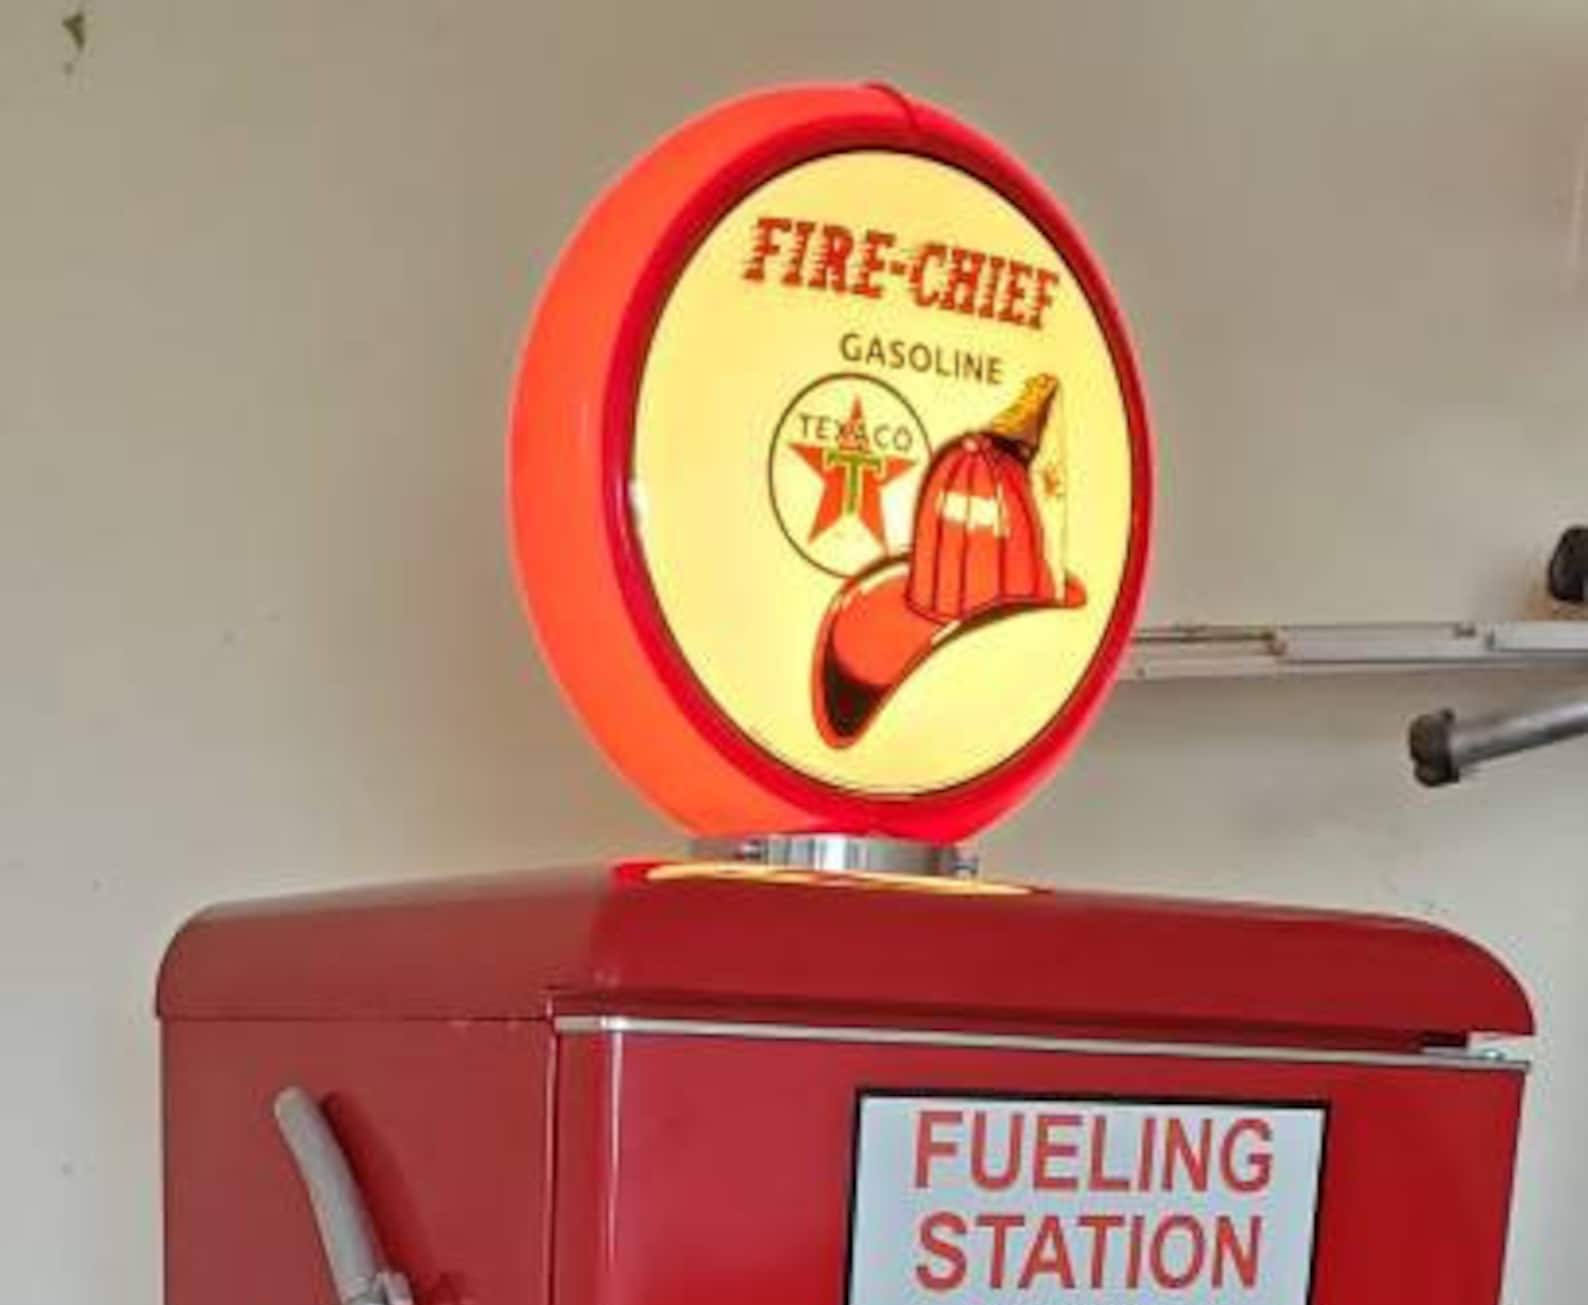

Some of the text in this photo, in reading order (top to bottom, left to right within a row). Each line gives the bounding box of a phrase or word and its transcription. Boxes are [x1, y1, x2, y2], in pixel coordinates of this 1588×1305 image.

[743, 216, 1058, 331] FIRE-CHIEF
[839, 332, 1003, 386] GASOLINE
[799, 412, 913, 452] TEXACO
[914, 1110, 1274, 1194] FUELING
[915, 1211, 1261, 1292] STATION
